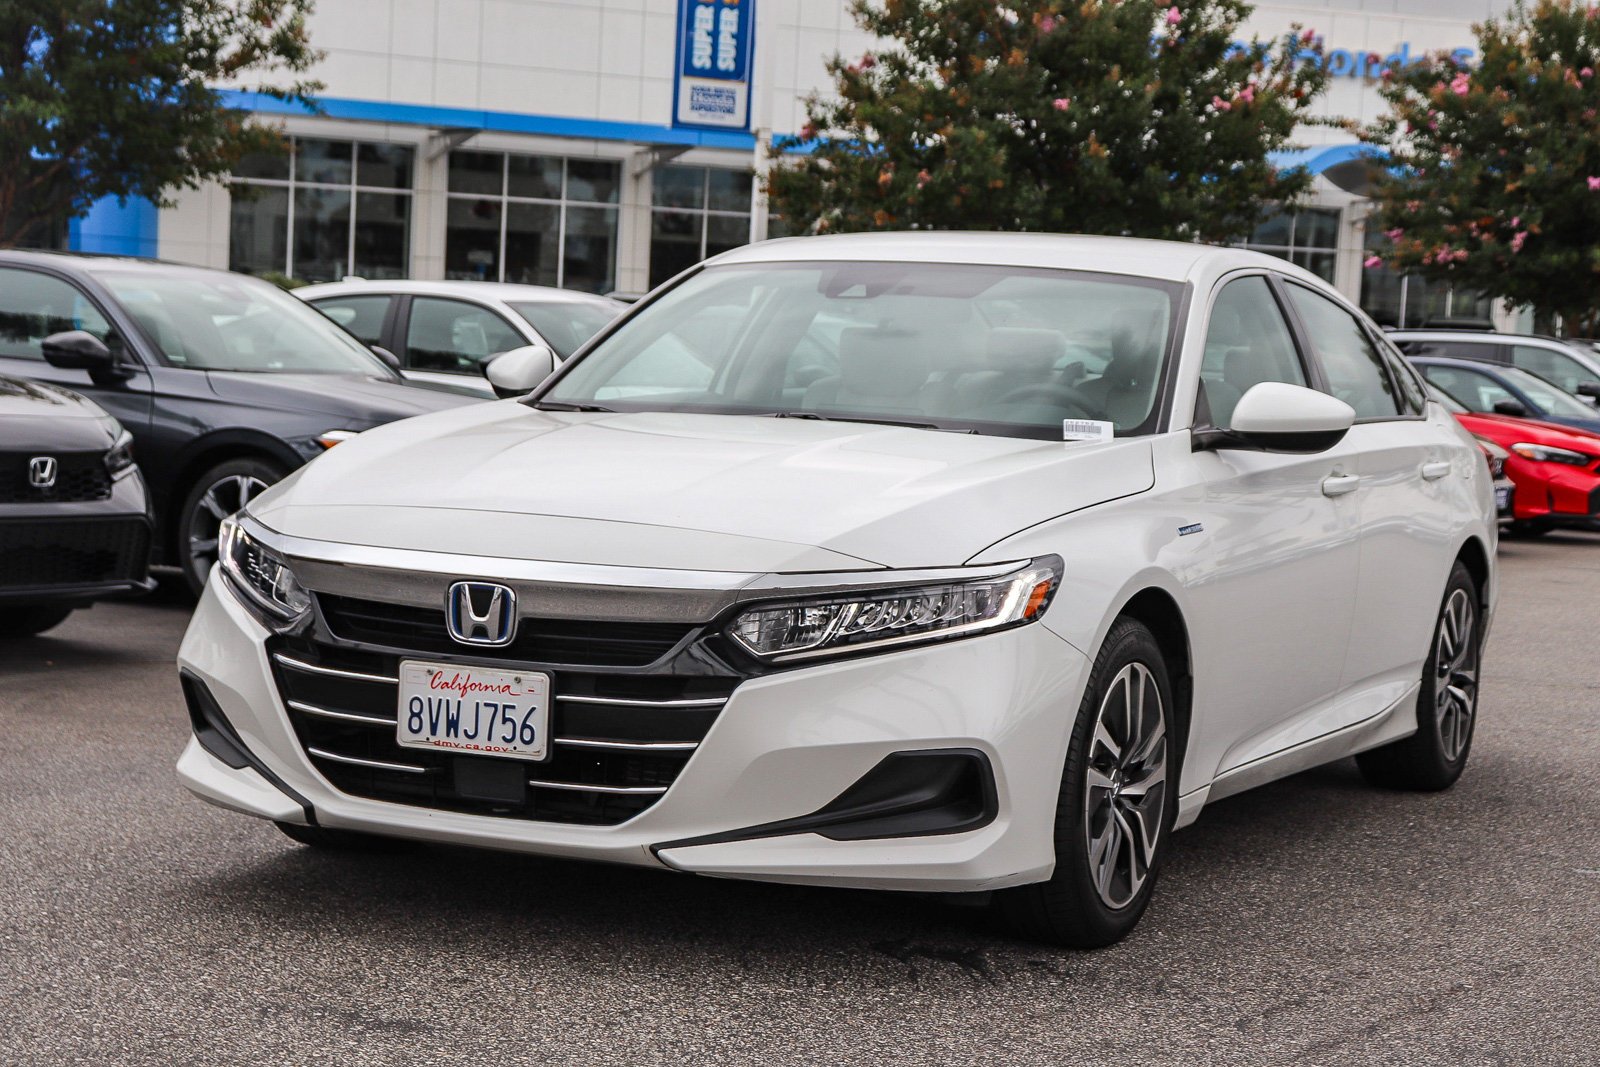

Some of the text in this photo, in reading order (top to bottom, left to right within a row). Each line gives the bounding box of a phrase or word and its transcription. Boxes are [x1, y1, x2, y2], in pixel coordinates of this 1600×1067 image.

[692, 4, 715, 70] SUPER
[717, 7, 740, 72] SUPER
[431, 671, 521, 698] California
[407, 696, 537, 746] 8VWJ756
